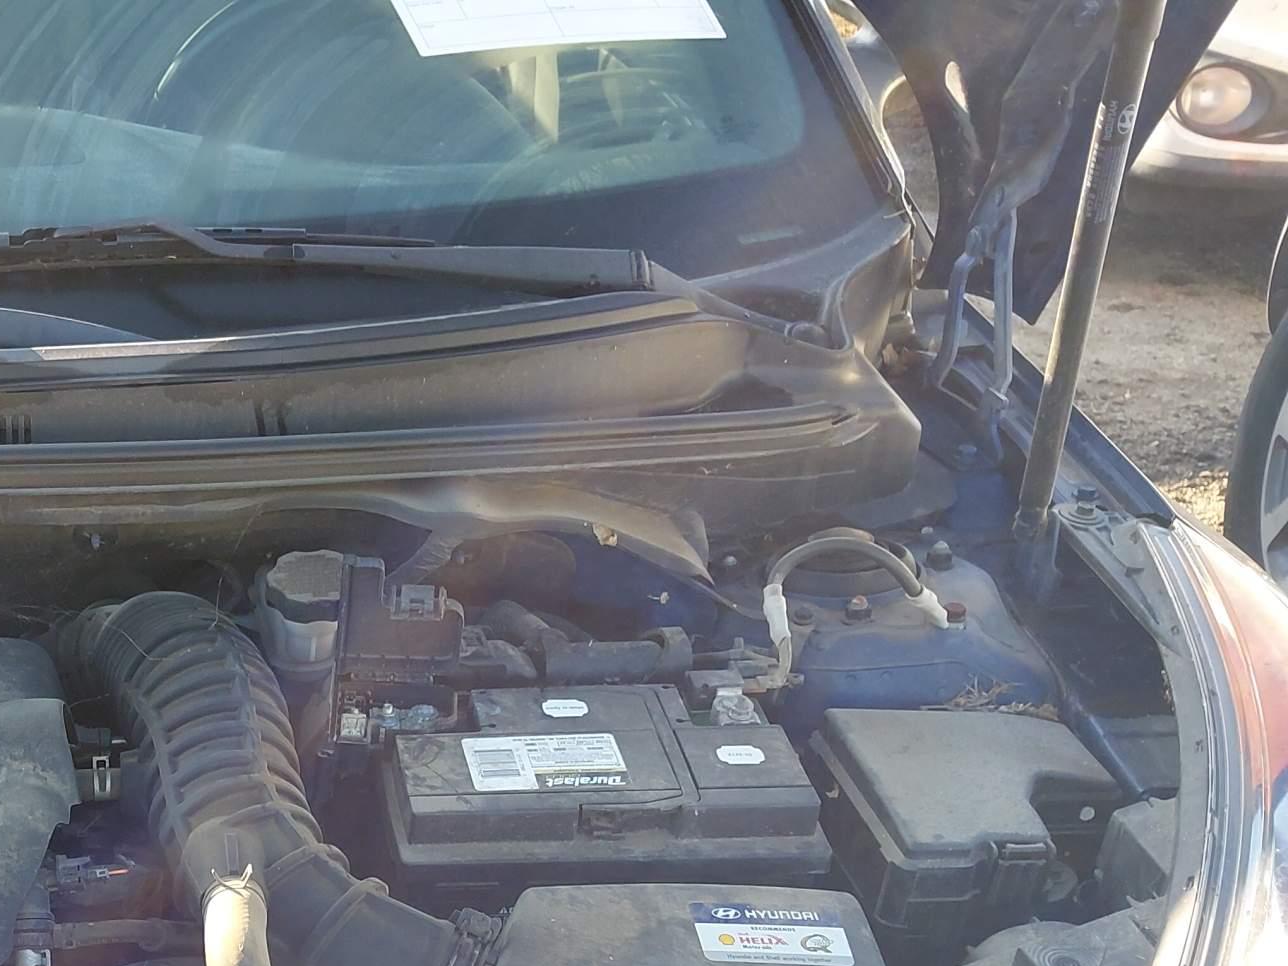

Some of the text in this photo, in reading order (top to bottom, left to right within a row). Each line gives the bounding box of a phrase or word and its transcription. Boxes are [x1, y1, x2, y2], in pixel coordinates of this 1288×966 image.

[545, 774, 626, 788] Duralast
[744, 909, 820, 921] HYUNDAI
[739, 935, 790, 946] HELIX
